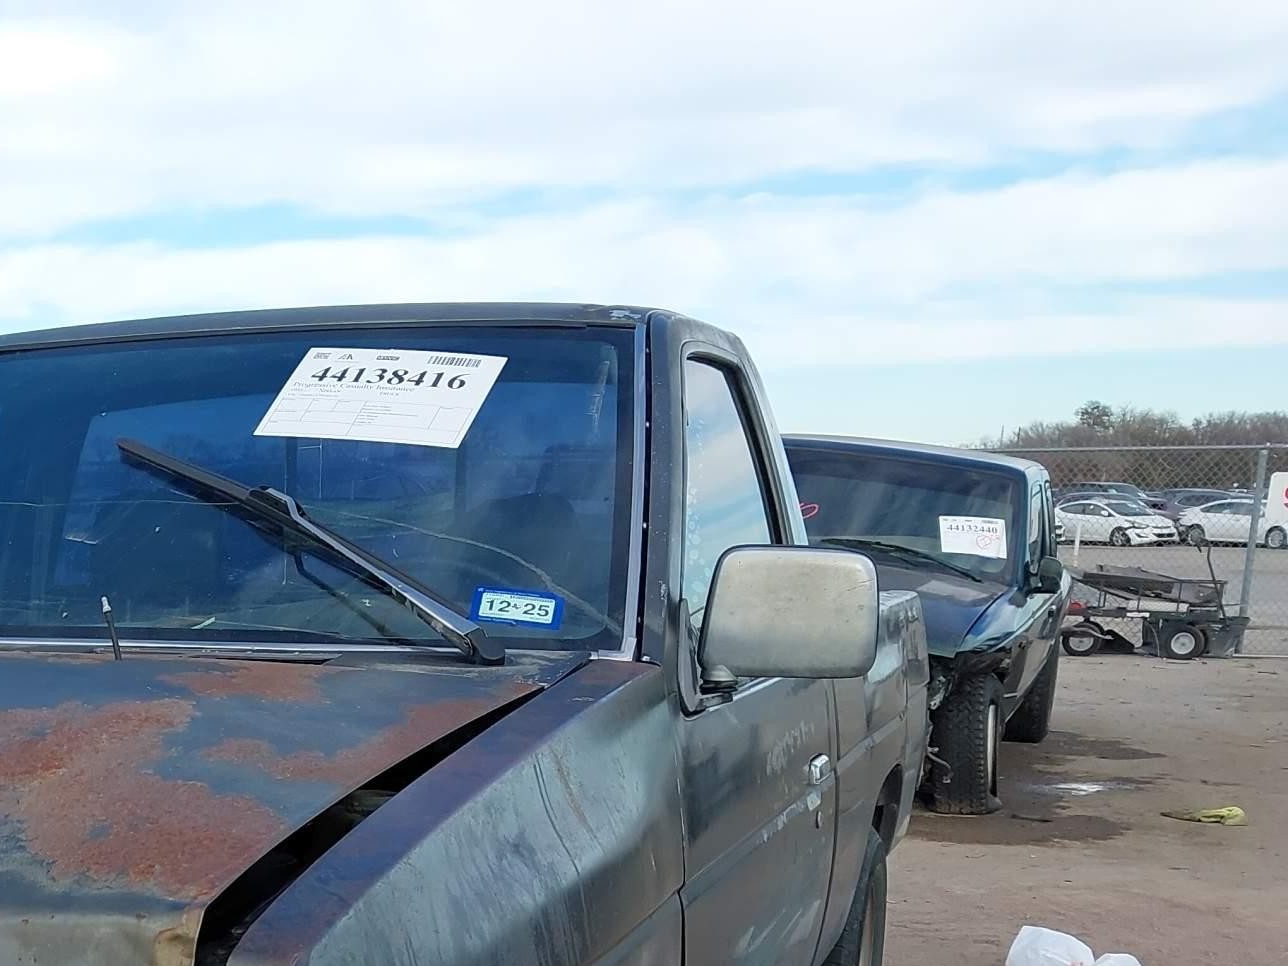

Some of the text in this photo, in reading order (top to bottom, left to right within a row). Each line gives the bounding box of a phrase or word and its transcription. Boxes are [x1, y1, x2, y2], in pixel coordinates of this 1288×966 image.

[310, 366, 472, 390] 44138416
[946, 523, 998, 534] 44132440
[486, 599, 550, 617] 12 25
